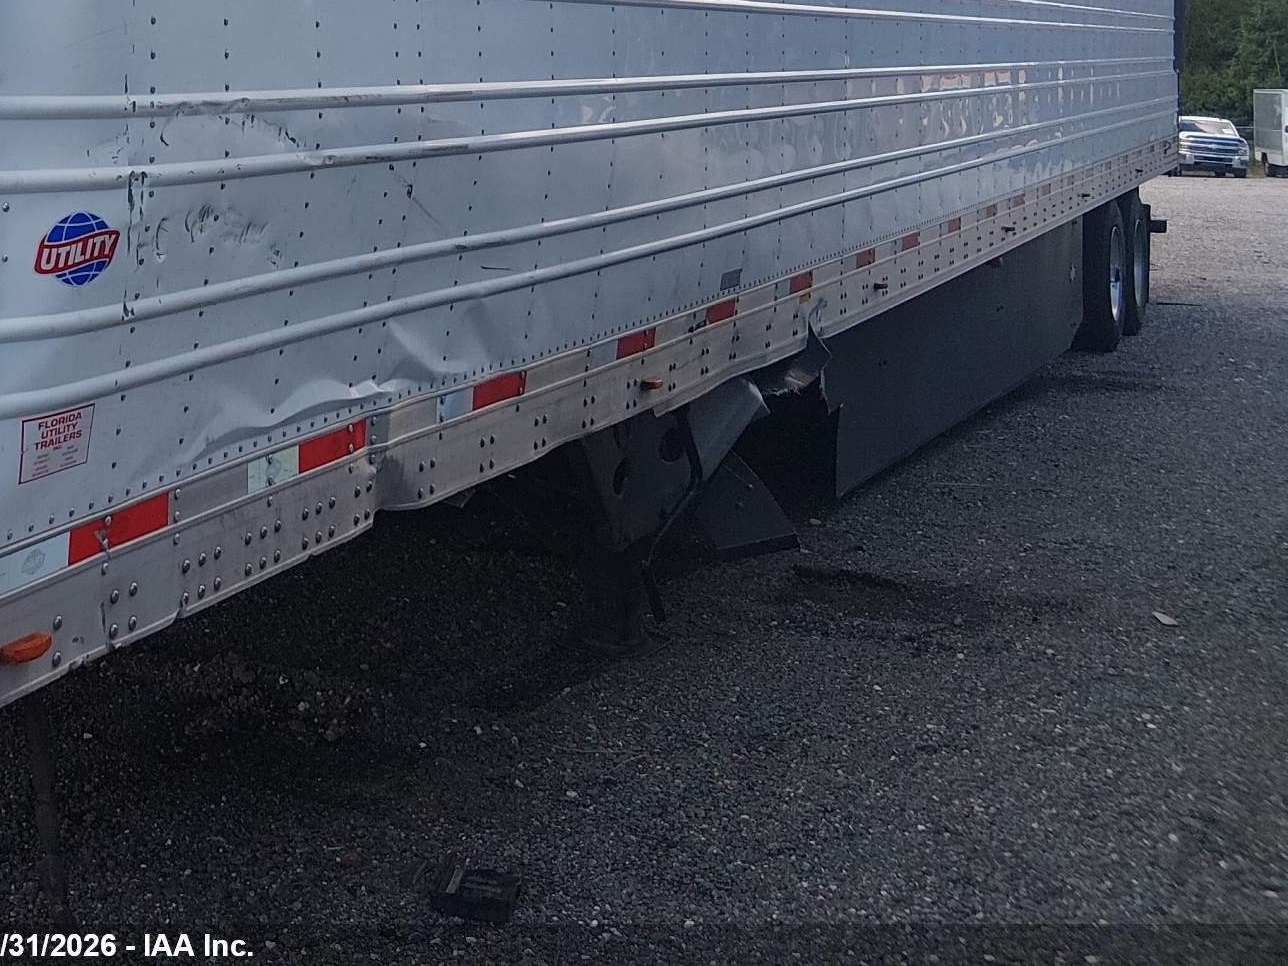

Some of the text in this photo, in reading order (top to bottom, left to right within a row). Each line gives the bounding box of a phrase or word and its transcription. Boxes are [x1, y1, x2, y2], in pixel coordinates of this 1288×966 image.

[40, 233, 116, 270] UTILITY
[38, 412, 82, 430] FLORIDA
[41, 422, 79, 439] UTILITY
[34, 430, 83, 450] TRAILERS
